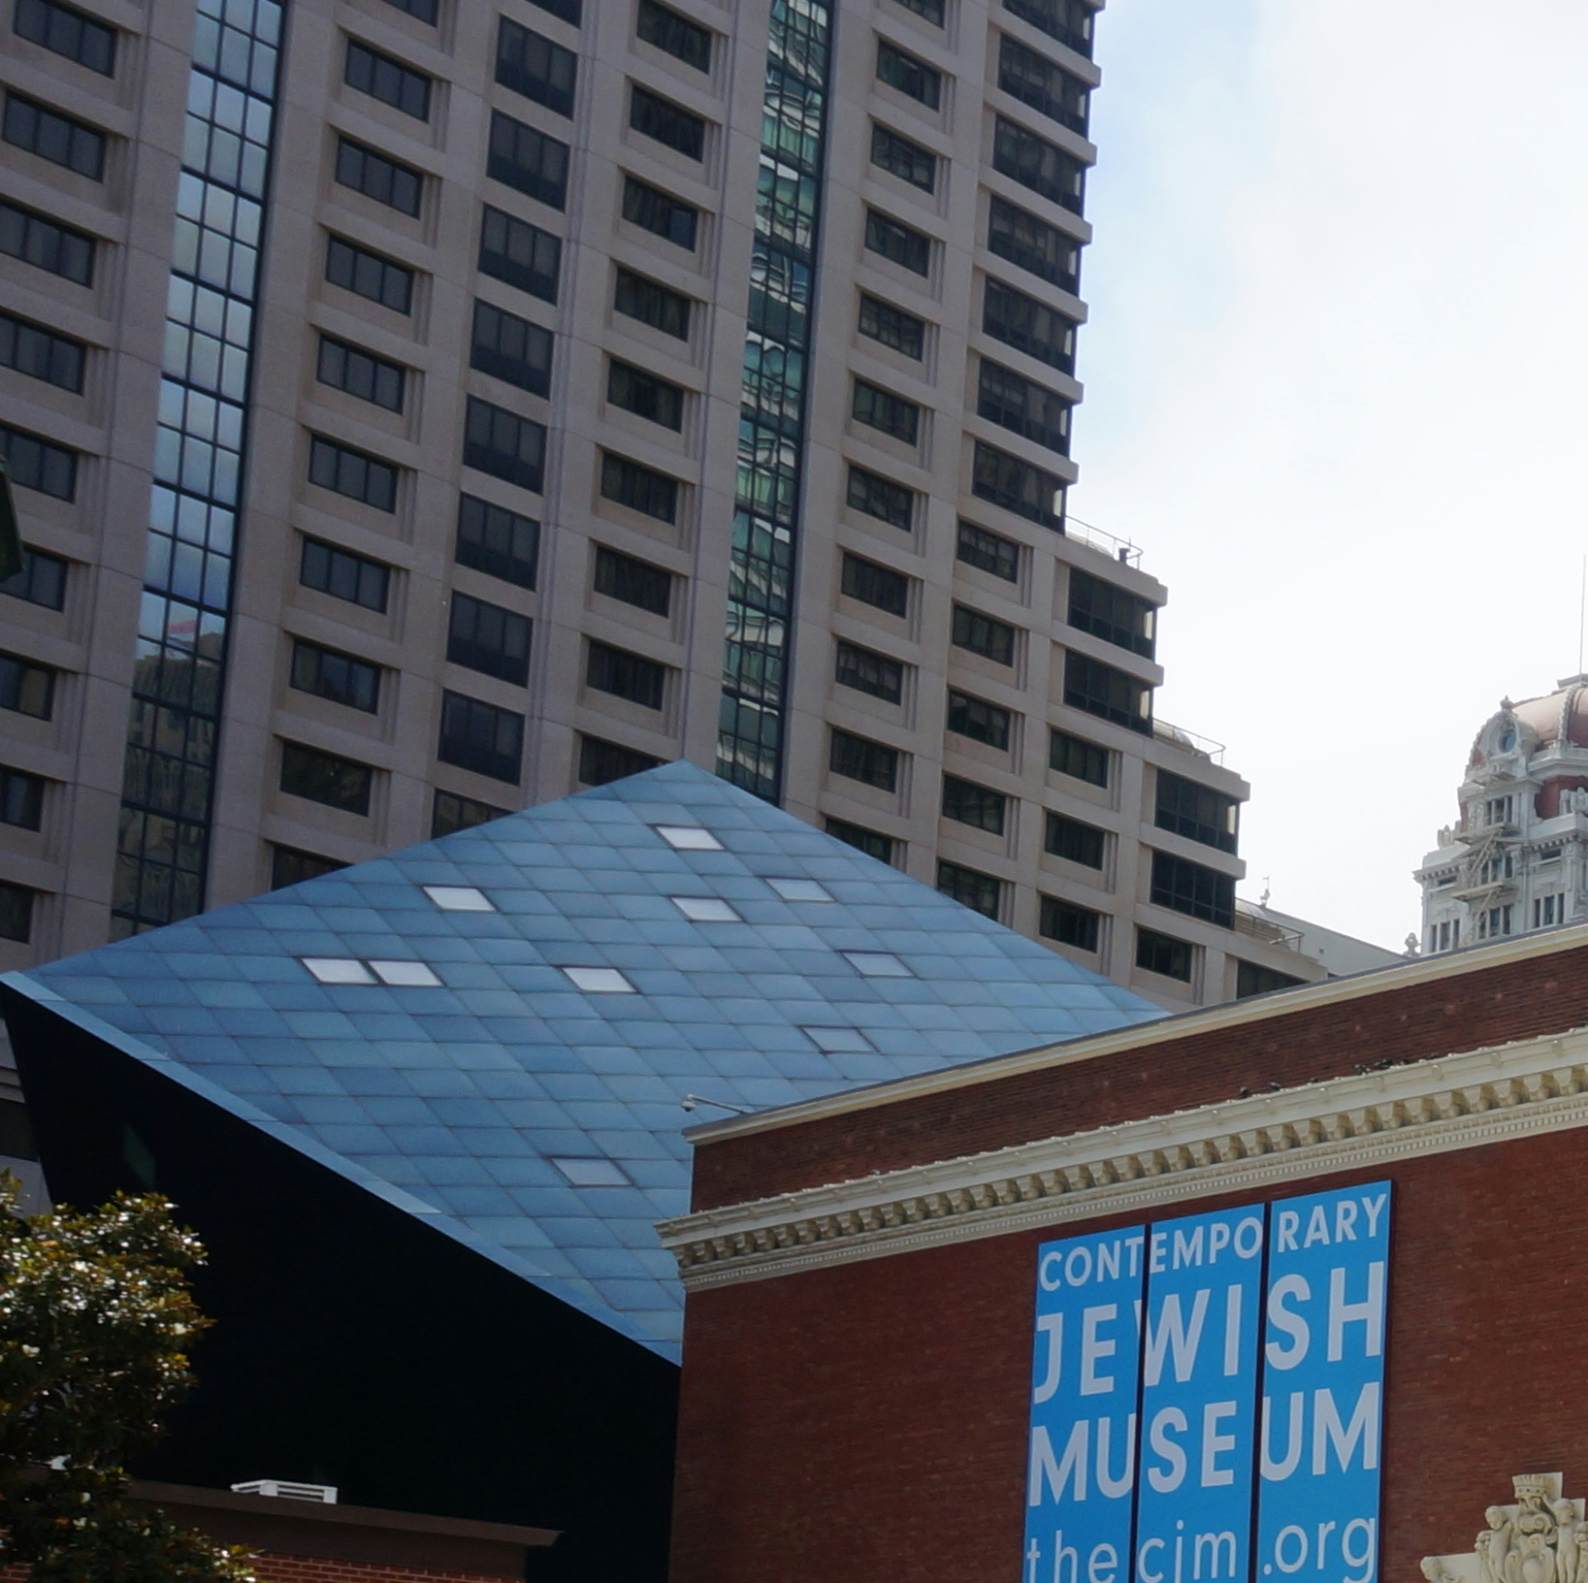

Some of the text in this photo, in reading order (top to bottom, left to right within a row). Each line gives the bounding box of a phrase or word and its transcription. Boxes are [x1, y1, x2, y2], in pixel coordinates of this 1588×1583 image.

[1038, 1193, 1387, 1291] CONTEMPORARY
[1033, 1260, 1384, 1404] JEWISH
[1028, 1381, 1379, 1507] MUSEUM
